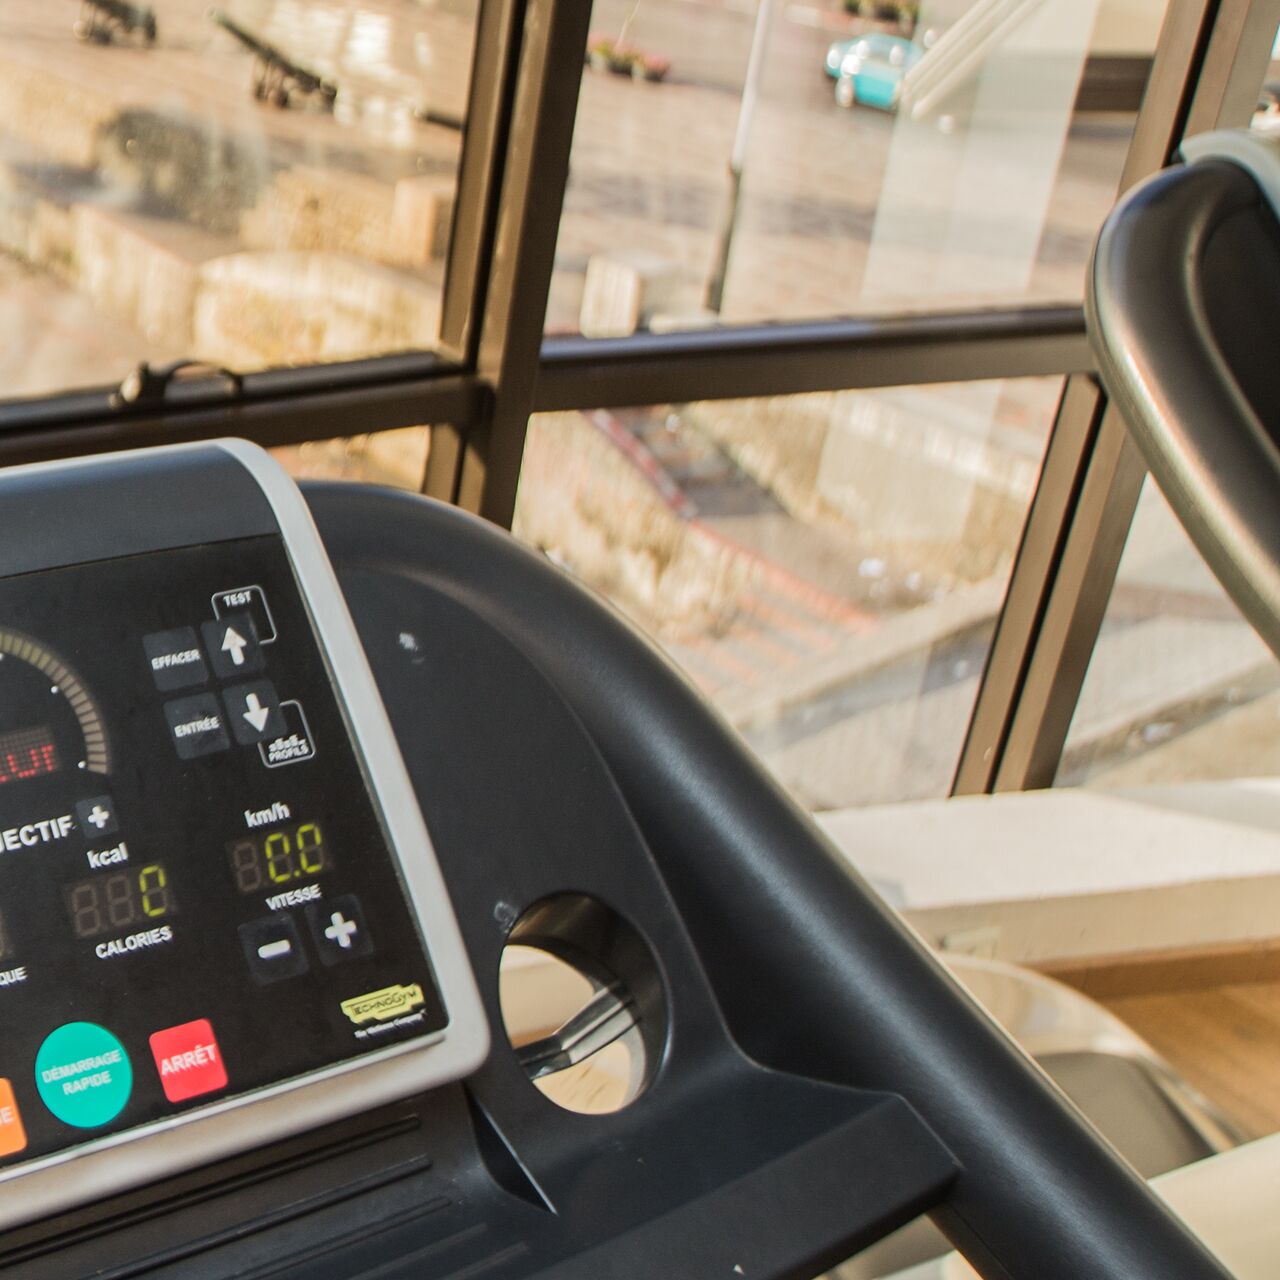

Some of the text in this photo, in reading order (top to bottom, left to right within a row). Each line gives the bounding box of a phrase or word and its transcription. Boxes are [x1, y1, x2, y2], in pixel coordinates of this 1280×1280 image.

[223, 590, 252, 606] TEST
[152, 649, 200, 670] EFFACER
[174, 716, 220, 739] ENTRÉE
[268, 744, 309, 763] PROFILS
[245, 803, 290, 828] km/h
[87, 843, 129, 869] kcal
[265, 884, 322, 911] VITESSE
[95, 925, 173, 959] CALORIES
[42, 1049, 122, 1084] DÉMARRAGE
[160, 1042, 217, 1076] ARRÊT
[62, 1070, 112, 1097] RAPIDE
